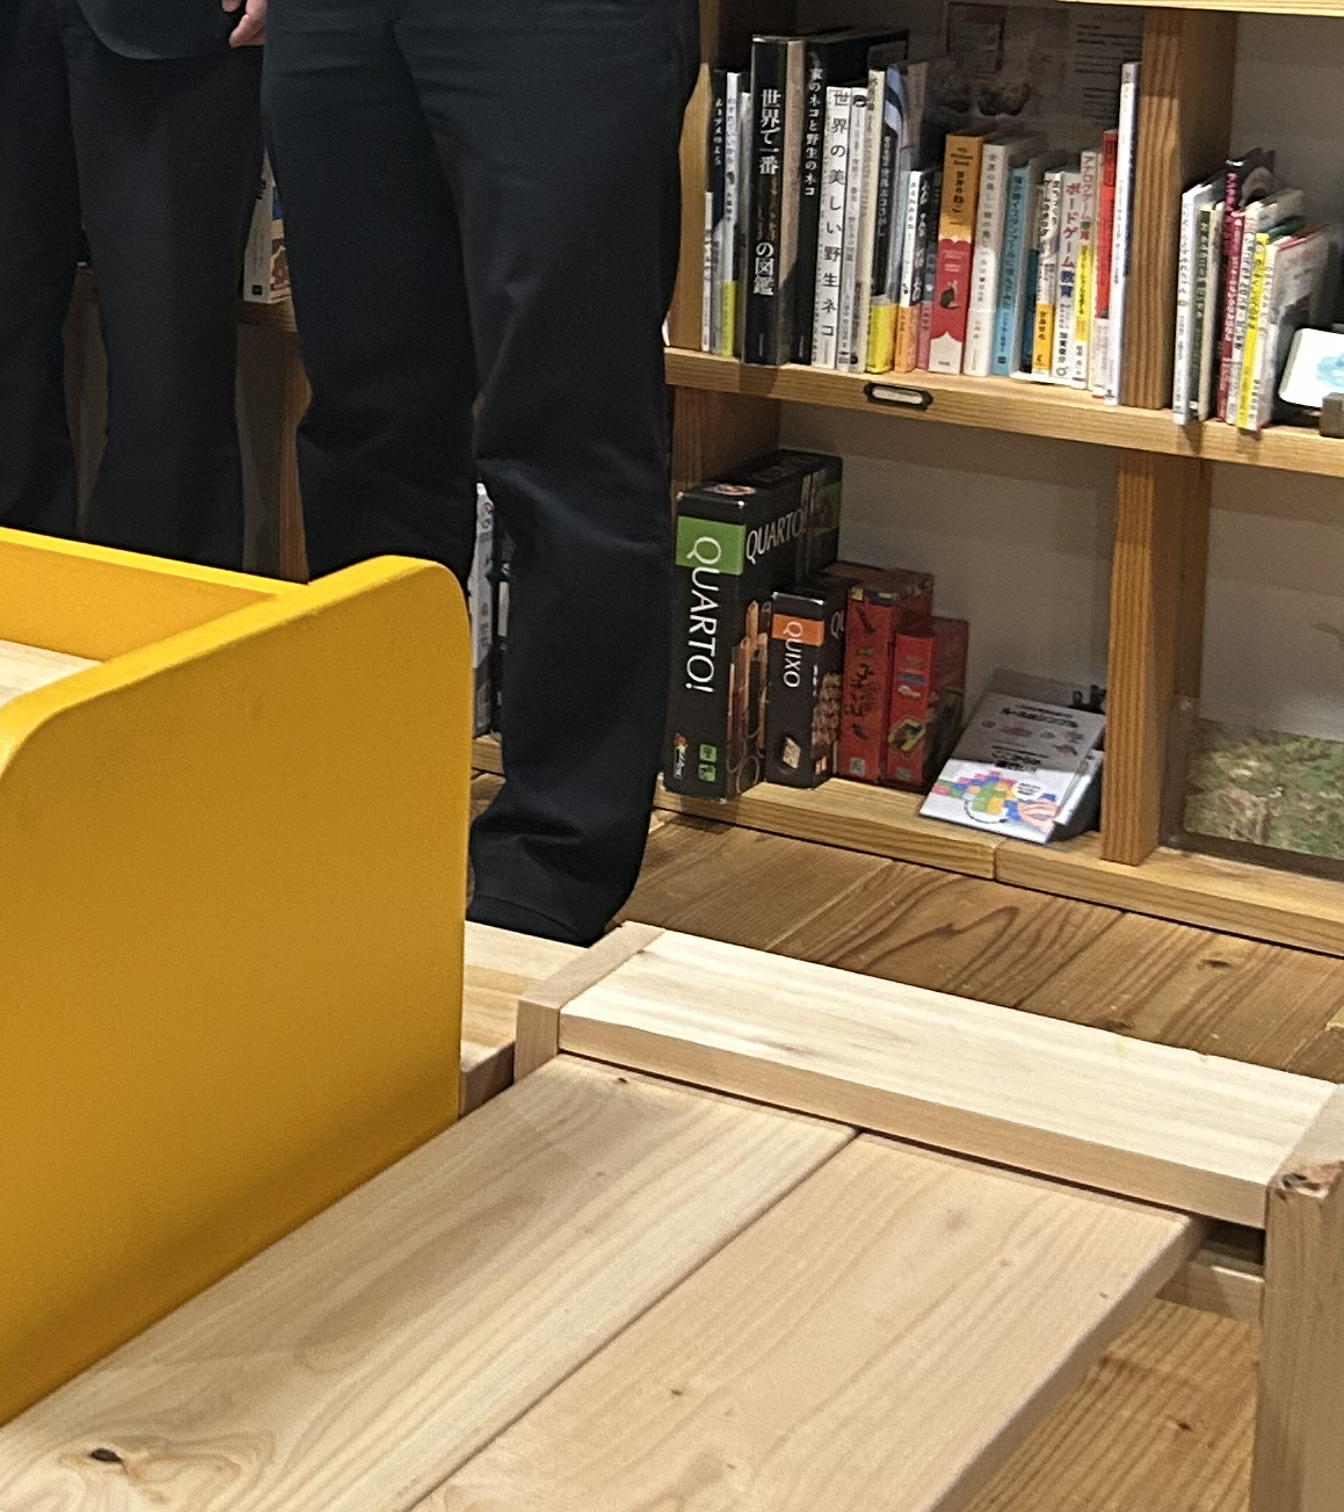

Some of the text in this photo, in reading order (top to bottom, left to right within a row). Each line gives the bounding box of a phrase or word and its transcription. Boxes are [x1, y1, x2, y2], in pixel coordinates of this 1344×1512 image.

[753, 88, 783, 296] 世界で一番 の図鑑
[820, 90, 850, 338] 世界の美しい野生ネコ
[1059, 182, 1081, 299] ボードゲーム教育
[685, 535, 722, 694] QUARTO!
[782, 620, 804, 688] QUIXO
